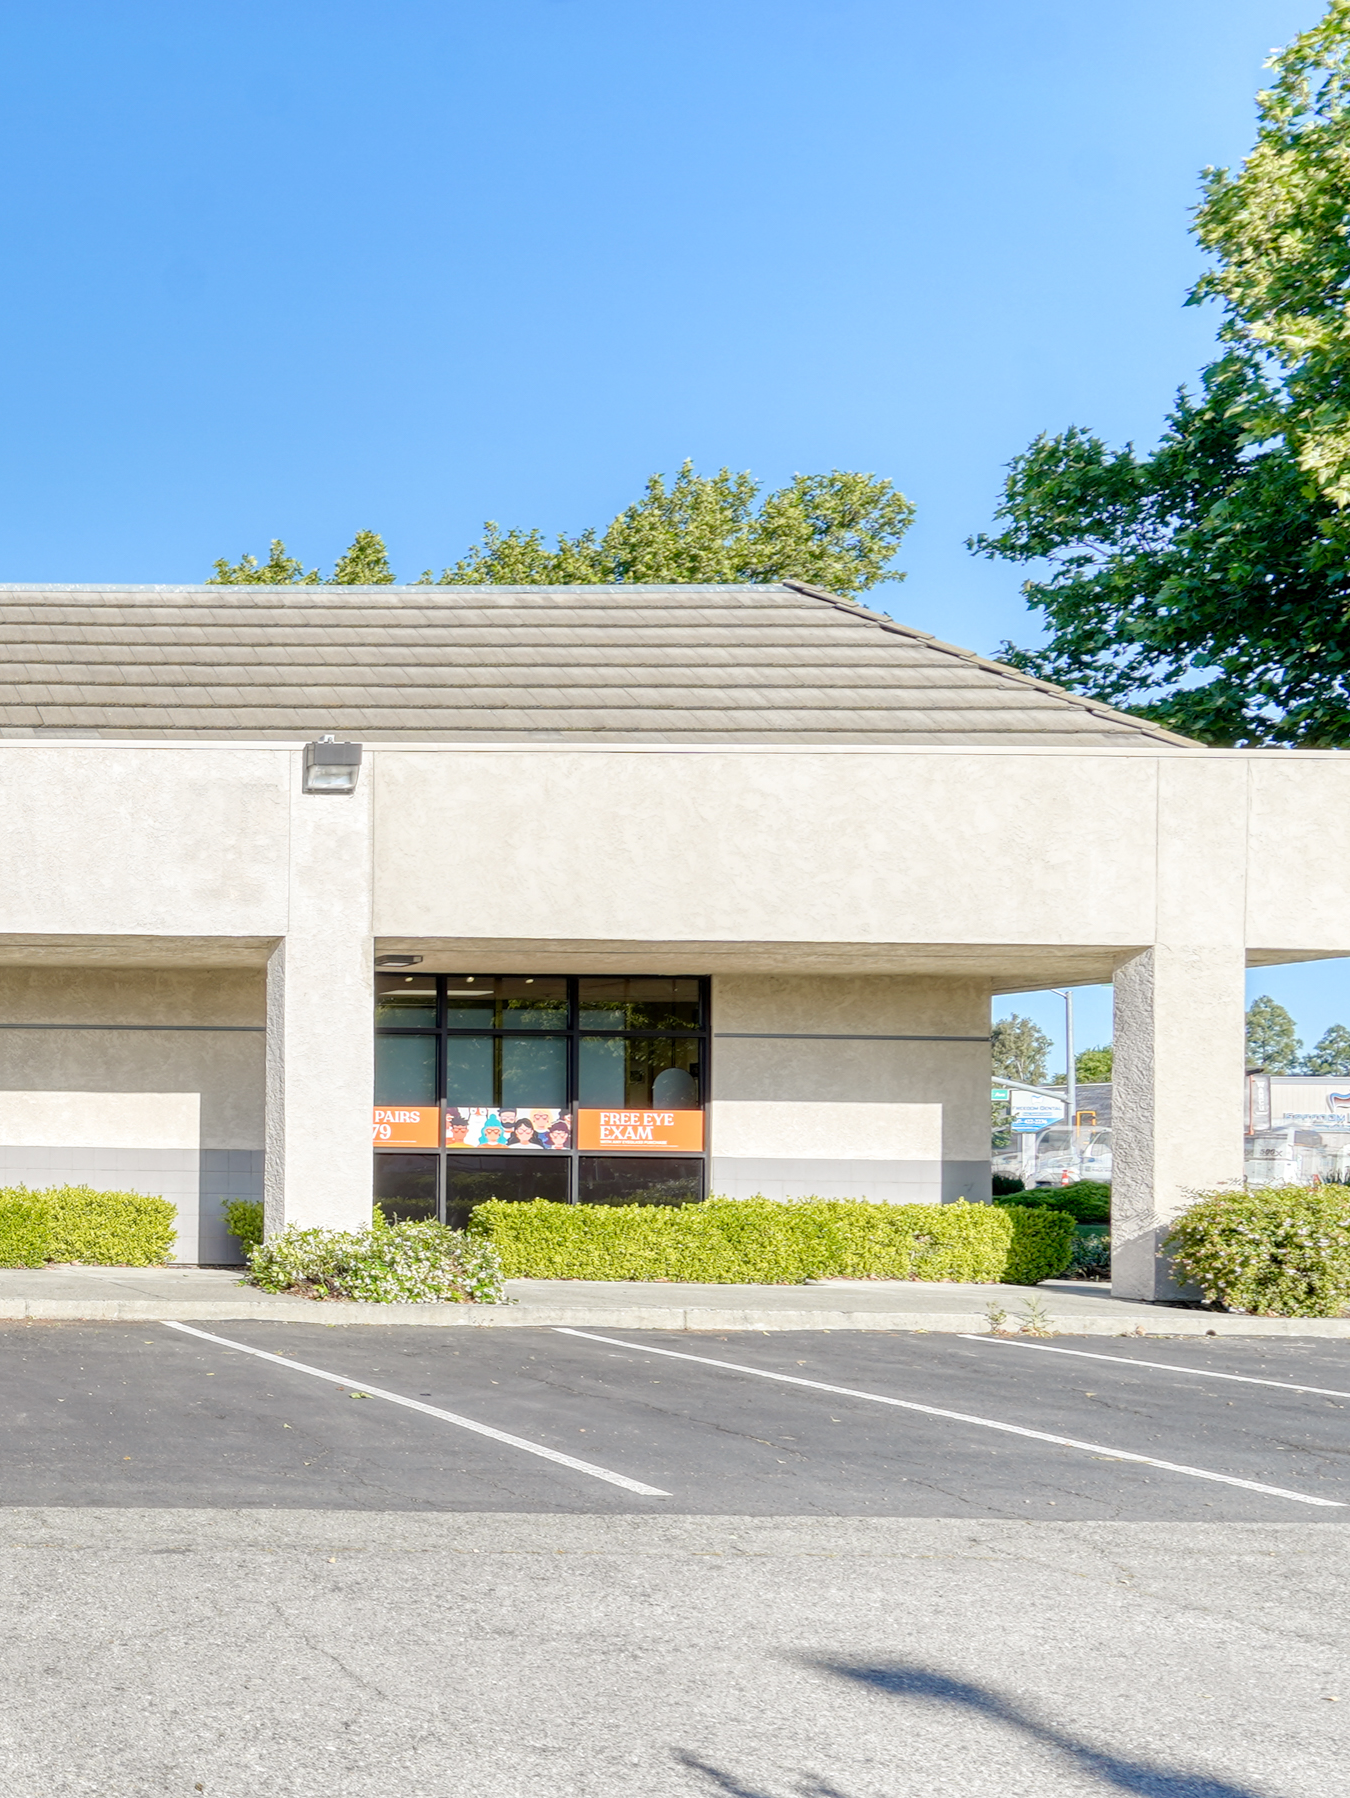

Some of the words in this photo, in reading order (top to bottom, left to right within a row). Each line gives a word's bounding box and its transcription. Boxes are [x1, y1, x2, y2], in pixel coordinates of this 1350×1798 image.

[375, 1111, 420, 1123] PAIRS
[600, 1112, 640, 1125] FREE
[643, 1113, 674, 1126] EYE
[600, 1126, 654, 1140] EXAM
